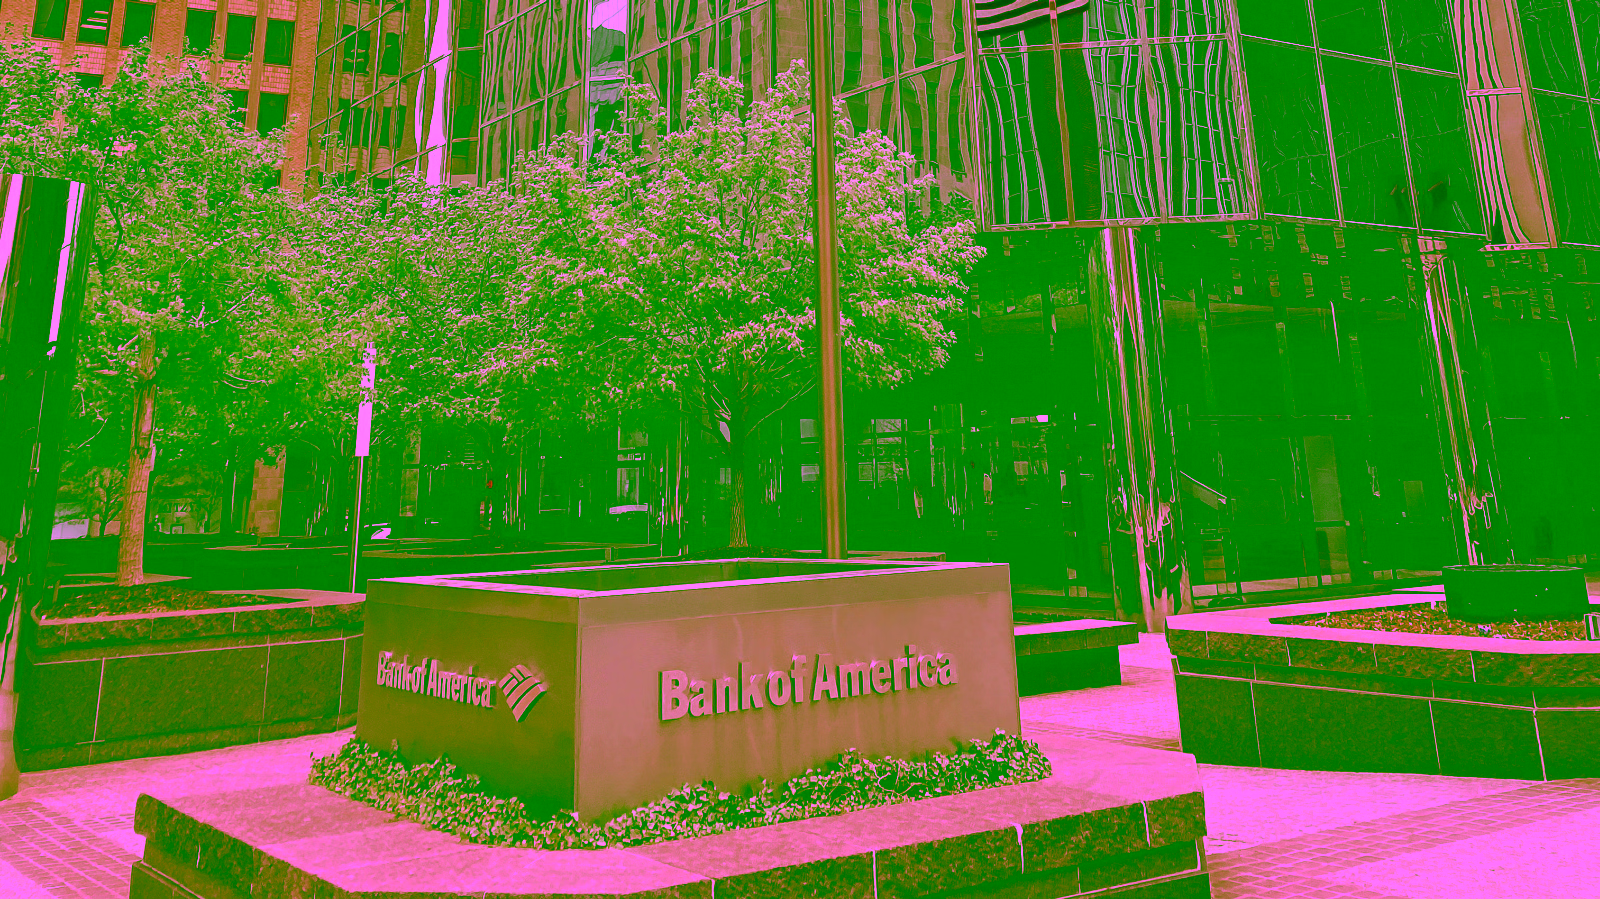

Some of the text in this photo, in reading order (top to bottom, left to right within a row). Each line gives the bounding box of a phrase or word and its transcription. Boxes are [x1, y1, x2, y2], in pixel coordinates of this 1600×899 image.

[377, 651, 493, 708] Bank of America
[660, 645, 958, 721] Bank of America
